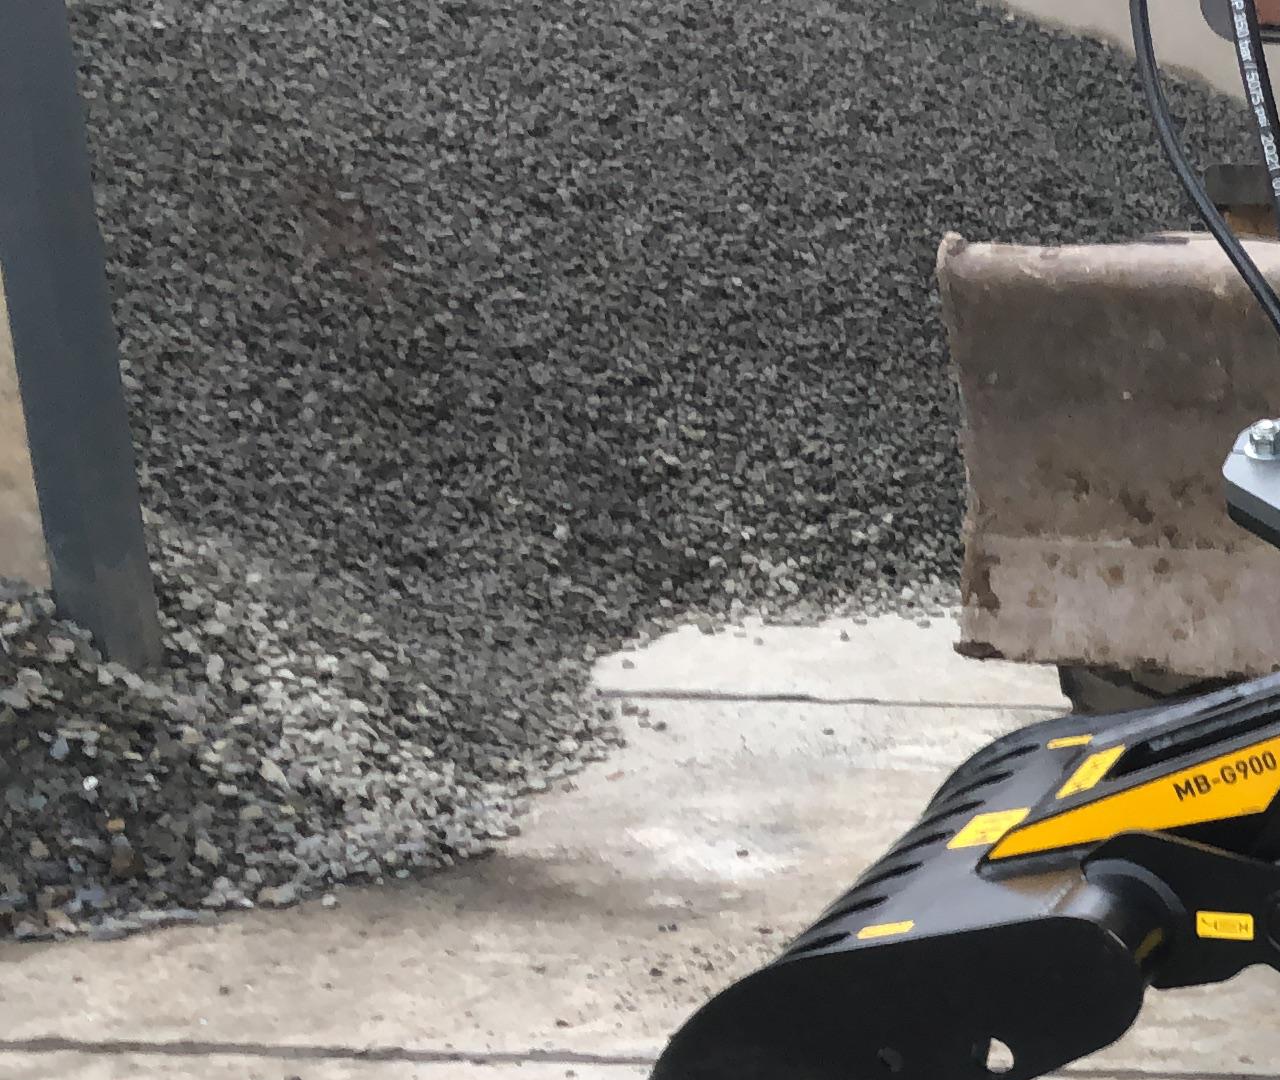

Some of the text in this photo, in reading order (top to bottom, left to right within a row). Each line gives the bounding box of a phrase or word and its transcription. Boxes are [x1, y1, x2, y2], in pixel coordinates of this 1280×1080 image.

[1238, 39, 1252, 61] bar
[1246, 71, 1264, 106] 5075
[1173, 751, 1277, 802] MB-G900
